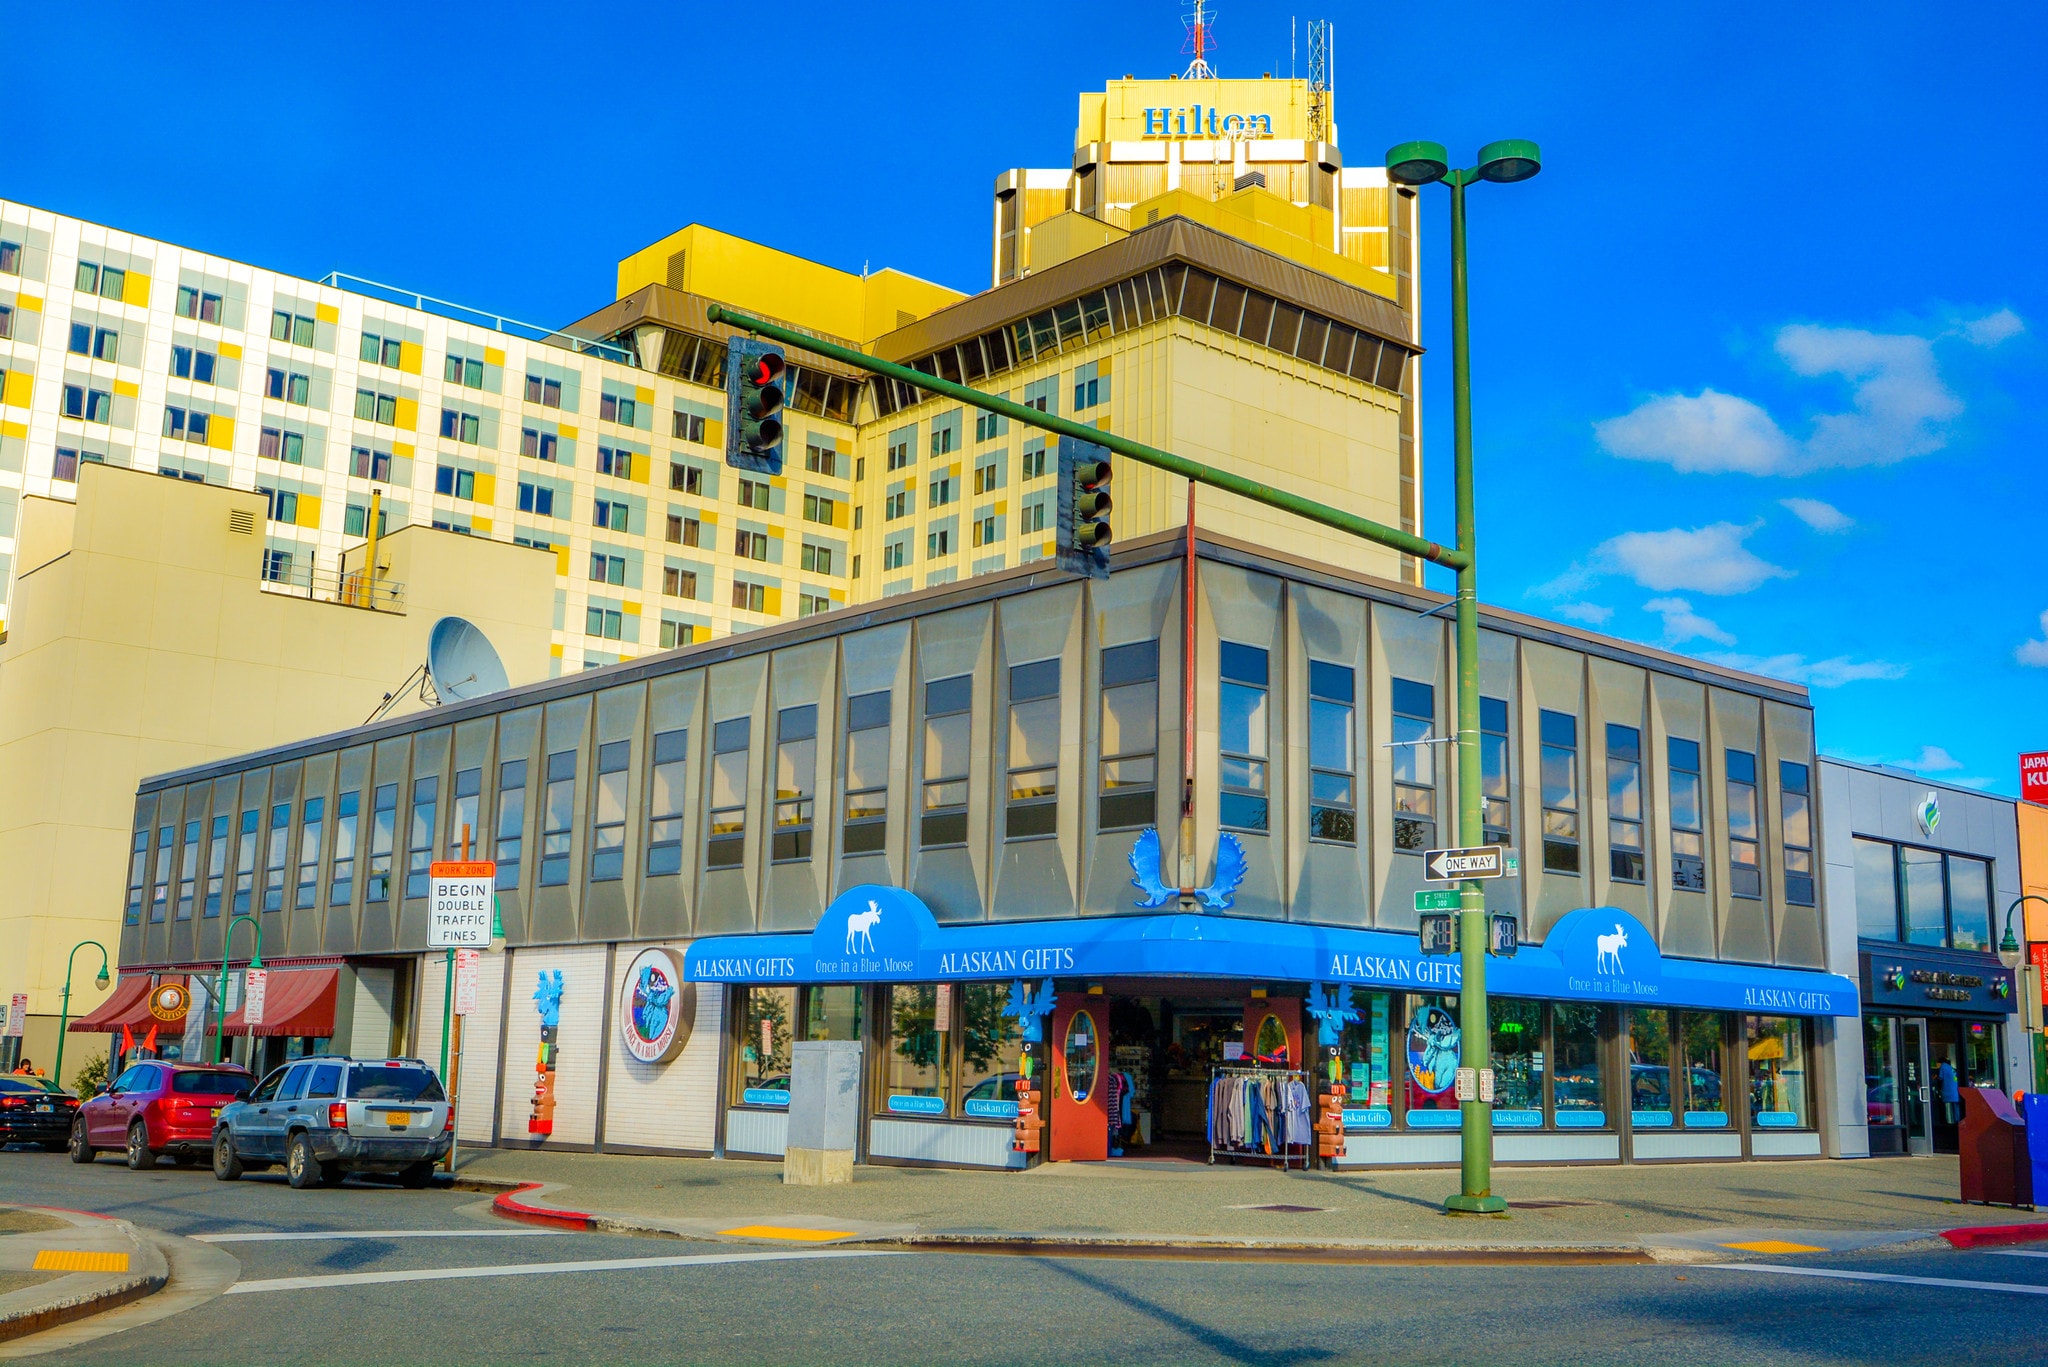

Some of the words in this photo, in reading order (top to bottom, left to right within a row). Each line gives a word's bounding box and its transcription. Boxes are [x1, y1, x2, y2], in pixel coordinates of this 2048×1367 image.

[1144, 104, 1273, 135] Hilton
[1446, 858, 1467, 870] ONE
[1470, 856, 1492, 868] WAY
[438, 867, 461, 875] WORK
[465, 866, 487, 875] ZONE
[438, 885, 486, 896] BEGIN
[438, 900, 484, 911] DOUBLE
[1425, 895, 1430, 906] F
[437, 915, 485, 925] TRAFFIC
[443, 931, 477, 941] FINES
[694, 958, 752, 977] ALASKAN
[755, 957, 795, 977] GIFTS
[815, 959, 838, 973] Once
[840, 959, 850, 973] in
[852, 962, 858, 973] a
[861, 958, 881, 972] Blue
[884, 957, 914, 972] Moose
[939, 950, 1016, 974] ALASKAN
[1022, 947, 1074, 971] GIFTS
[1330, 954, 1411, 980] ALASKAN
[1416, 961, 1461, 985] GIFTS
[1569, 976, 1591, 991] Once
[1593, 978, 1602, 992] in
[1604, 982, 1610, 992] a
[1612, 979, 1631, 994] Blue
[1633, 980, 1658, 996] Moose
[1744, 987, 1796, 1009] ALASKAN
[1799, 992, 1831, 1011] GIFTS
[153, 1006, 187, 1019] STATION
[626, 1025, 637, 1046] ONCE
[645, 1045, 657, 1058] BLUE
[657, 1028, 672, 1051] MOOSE
[972, 1102, 1001, 1113] Alaskan
[1341, 1112, 1367, 1123] laskan
[1368, 1112, 1386, 1123] Gifts
[1495, 1113, 1521, 1123] Alaskan
[1522, 1113, 1538, 1123] Gifts
